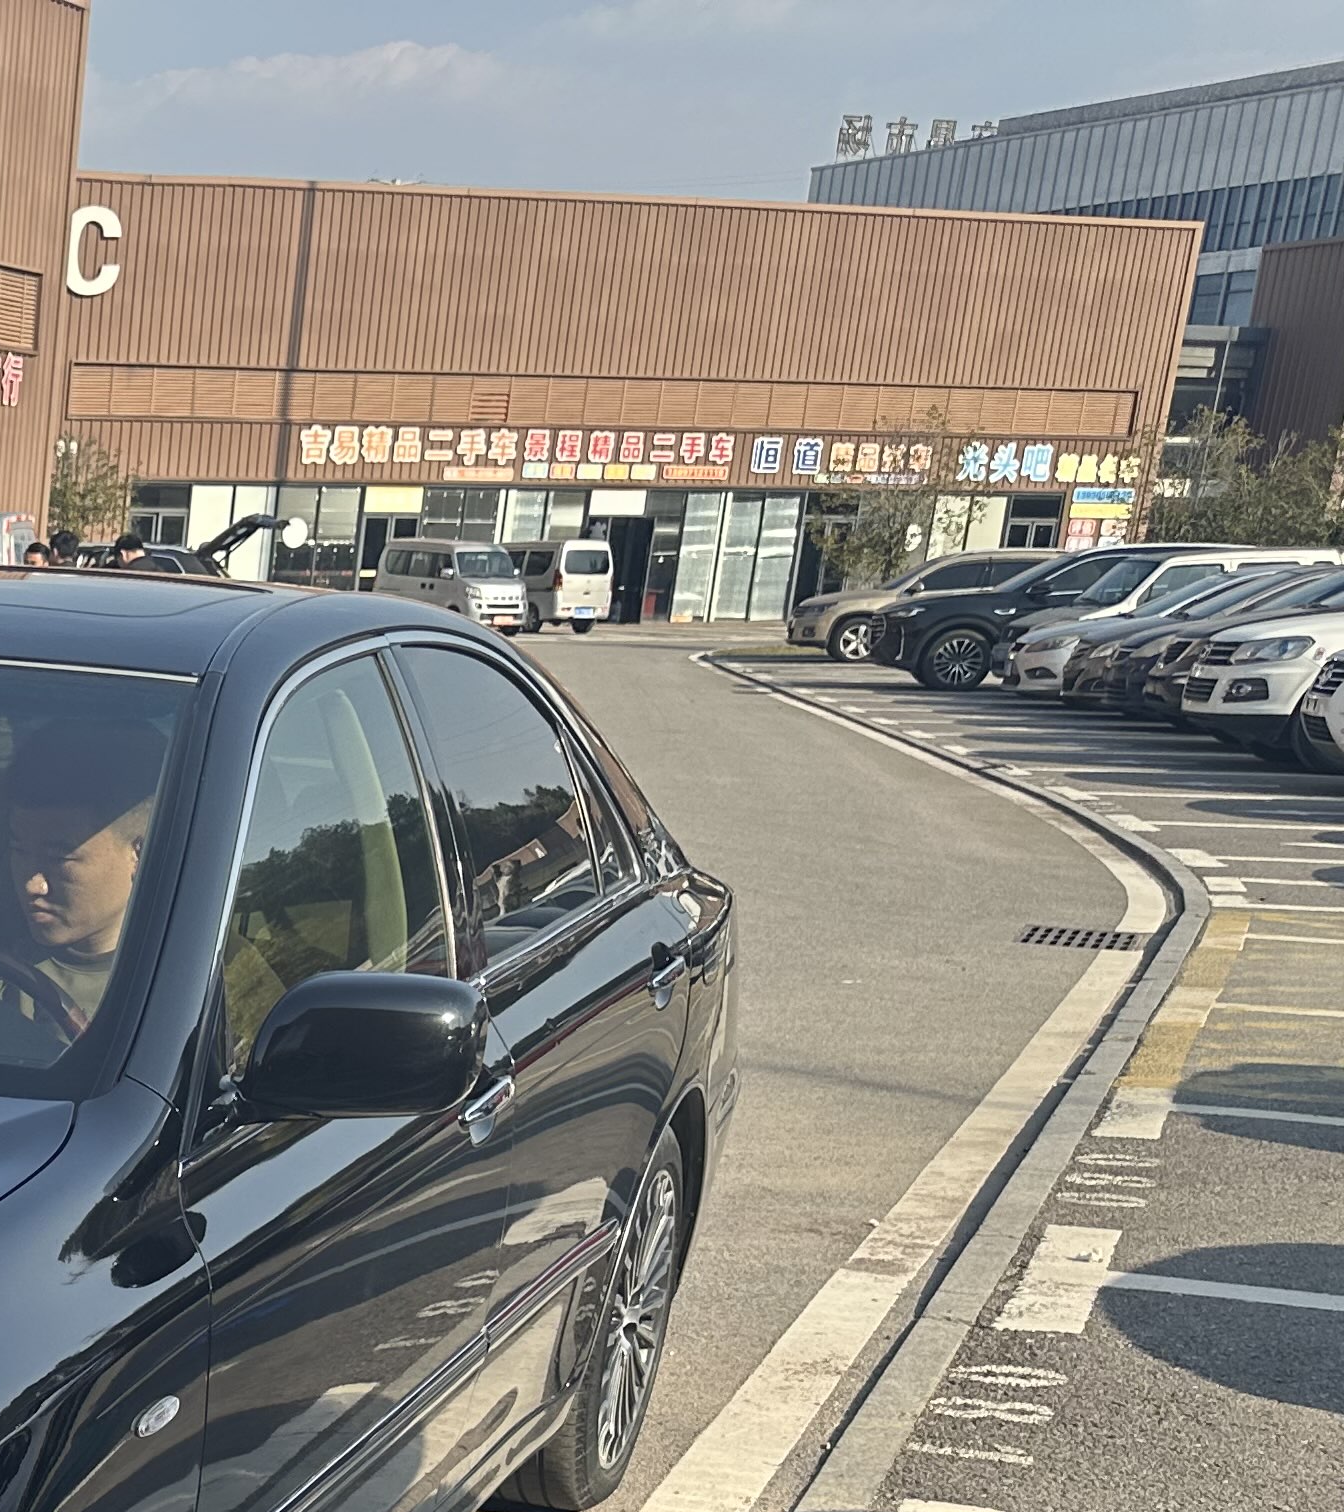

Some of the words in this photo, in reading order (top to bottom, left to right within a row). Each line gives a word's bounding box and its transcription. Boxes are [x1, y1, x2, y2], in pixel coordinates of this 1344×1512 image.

[66, 205, 122, 296] C
[300, 424, 518, 465] 吉易精品二手车
[524, 429, 735, 464] 景程精品二手车
[750, 437, 824, 475] 恒道
[956, 441, 1054, 483] 光头吧
